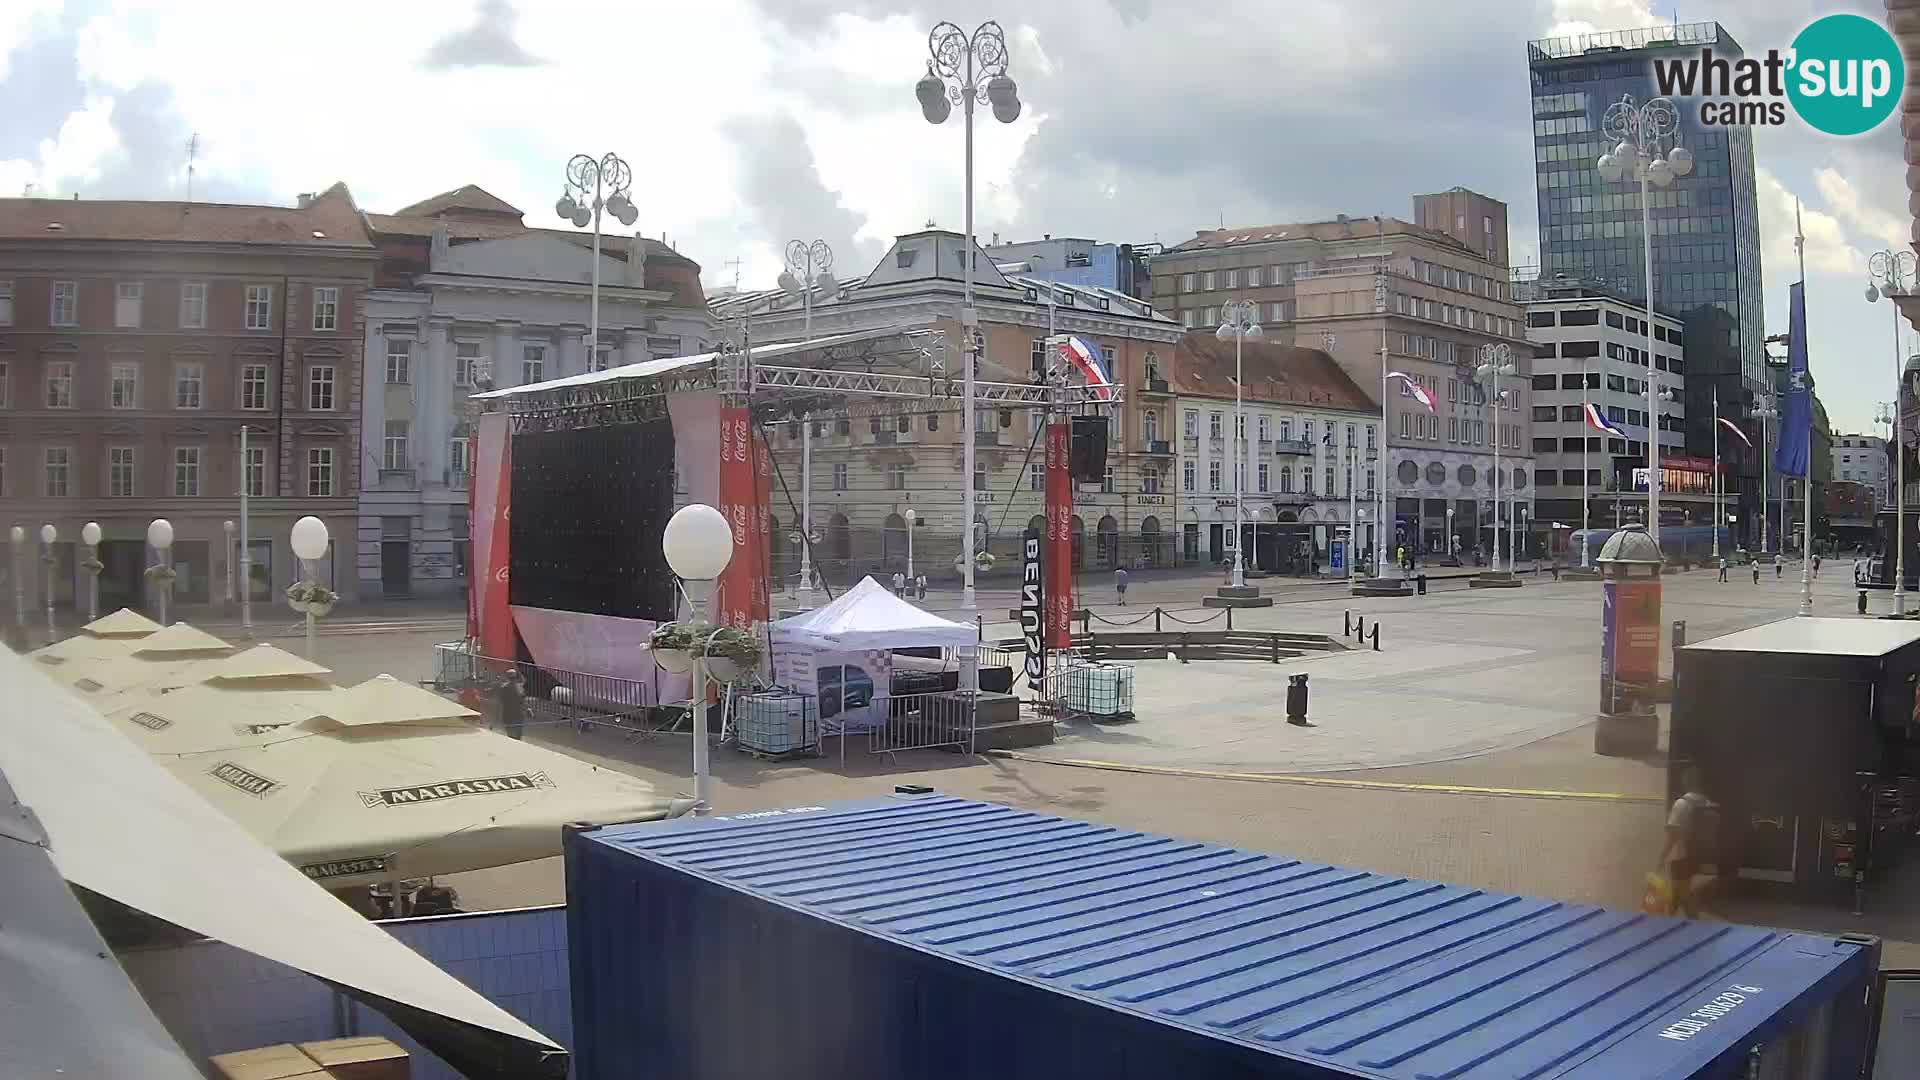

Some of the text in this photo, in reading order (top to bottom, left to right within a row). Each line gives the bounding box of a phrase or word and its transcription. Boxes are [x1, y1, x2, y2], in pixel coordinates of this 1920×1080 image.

[734, 420, 748, 462] Coca-Cola
[733, 503, 747, 545] Coca-Cola
[1060, 503, 1070, 542] Coca-Cola
[391, 777, 524, 803] MARASKA
